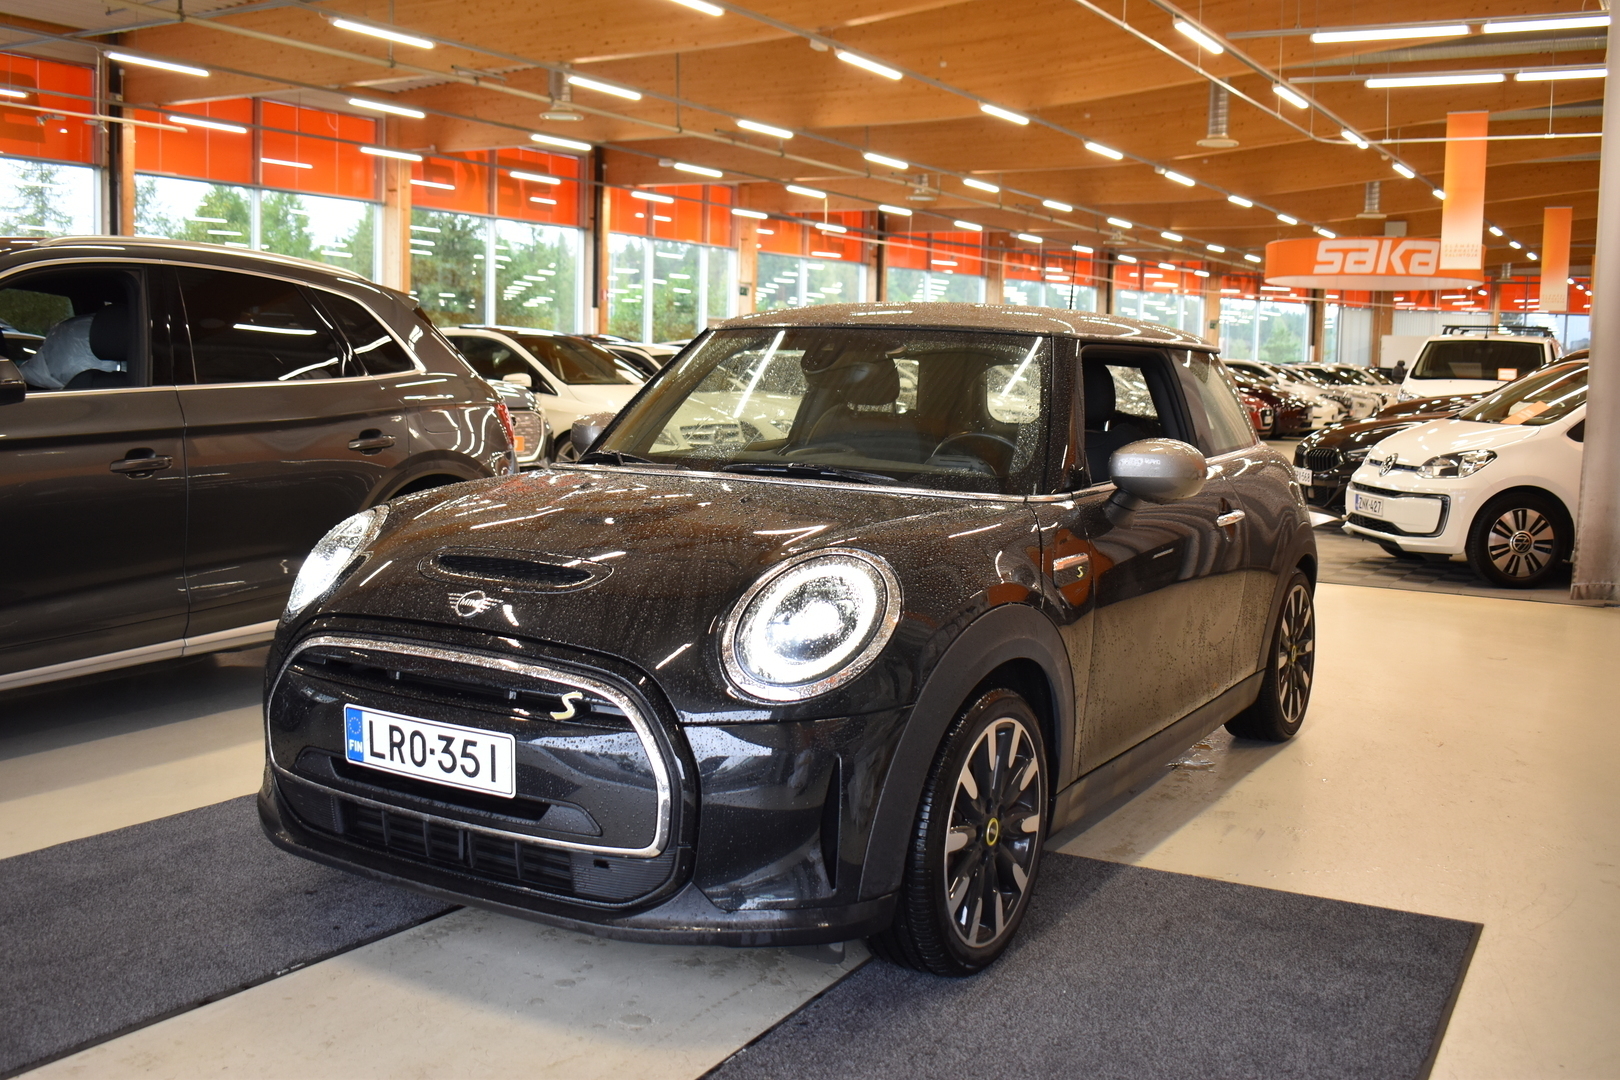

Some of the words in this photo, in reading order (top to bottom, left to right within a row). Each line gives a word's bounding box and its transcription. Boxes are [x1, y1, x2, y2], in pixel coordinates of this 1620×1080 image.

[1313, 239, 1440, 275] saka
[1358, 496, 1382, 513] ZNK-427
[349, 739, 363, 753] FIN
